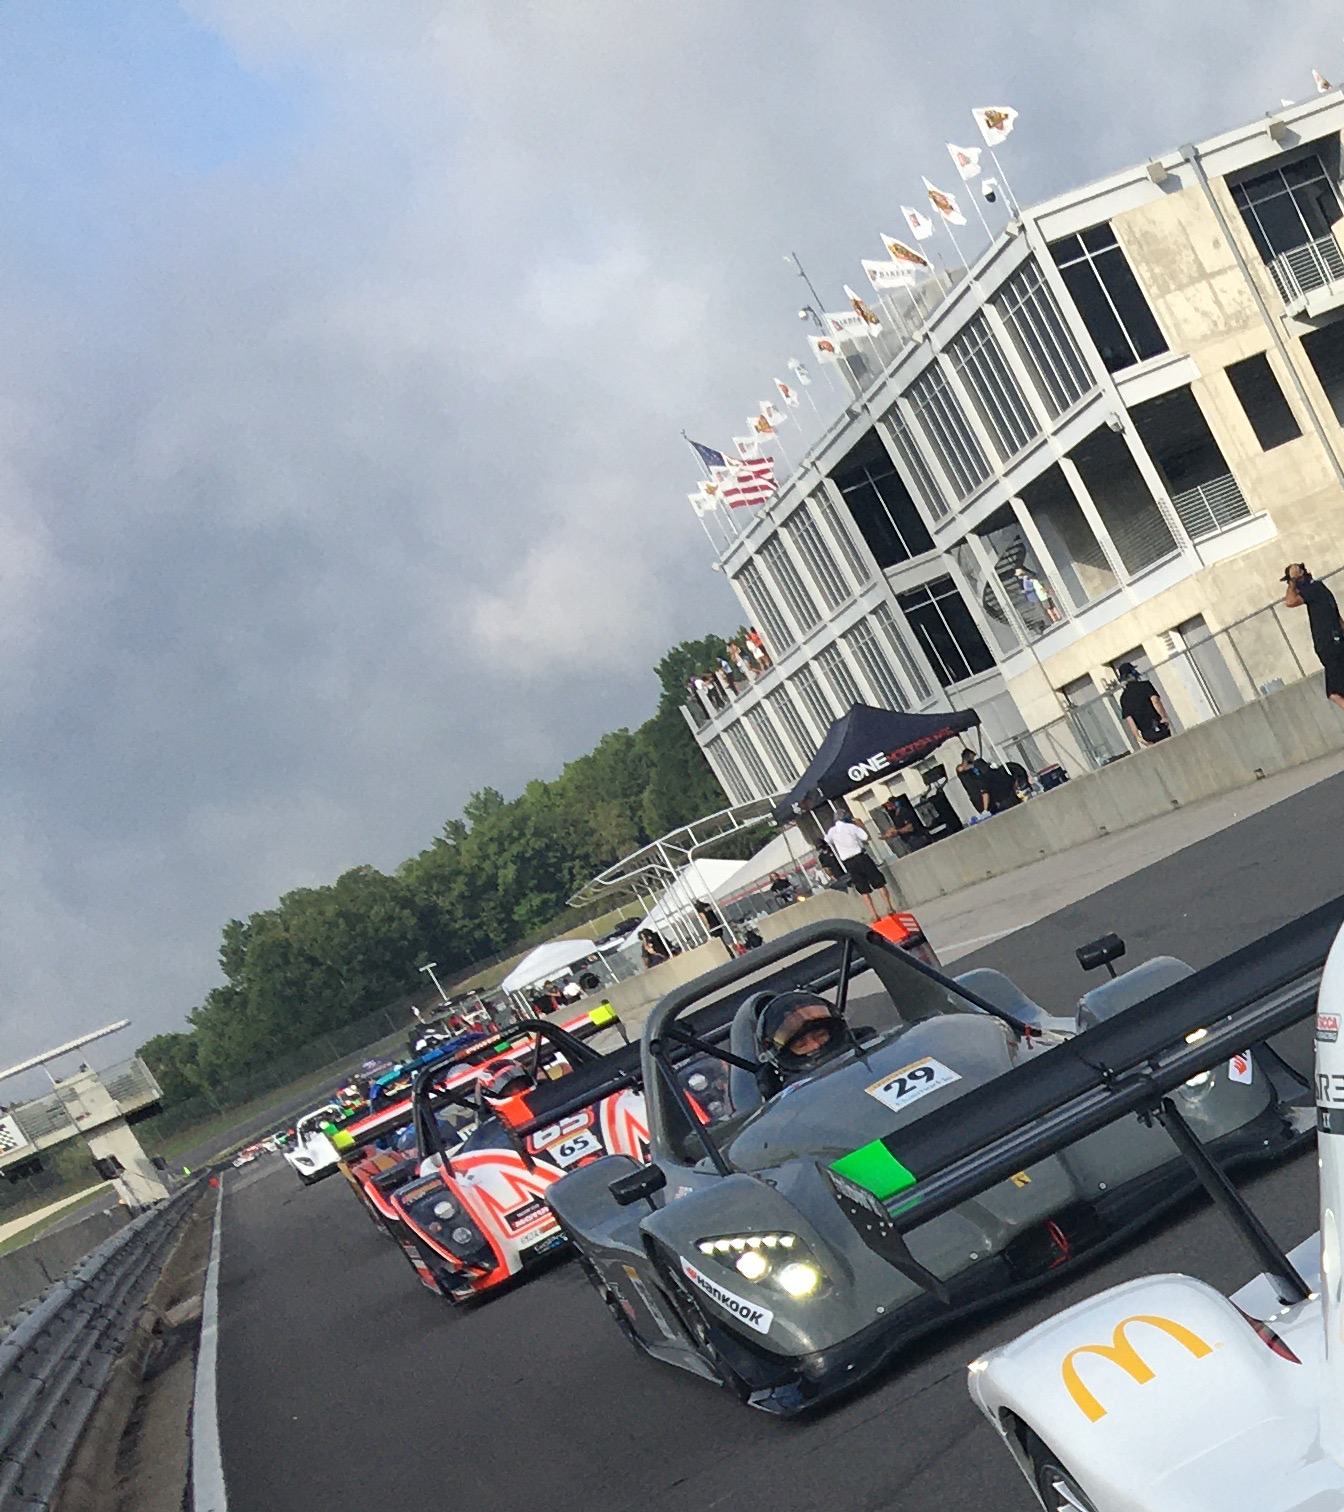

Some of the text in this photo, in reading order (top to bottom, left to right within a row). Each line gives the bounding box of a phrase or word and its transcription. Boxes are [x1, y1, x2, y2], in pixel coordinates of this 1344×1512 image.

[847, 751, 891, 782] ONE
[883, 1066, 935, 1100] 29
[559, 1136, 591, 1158] 65
